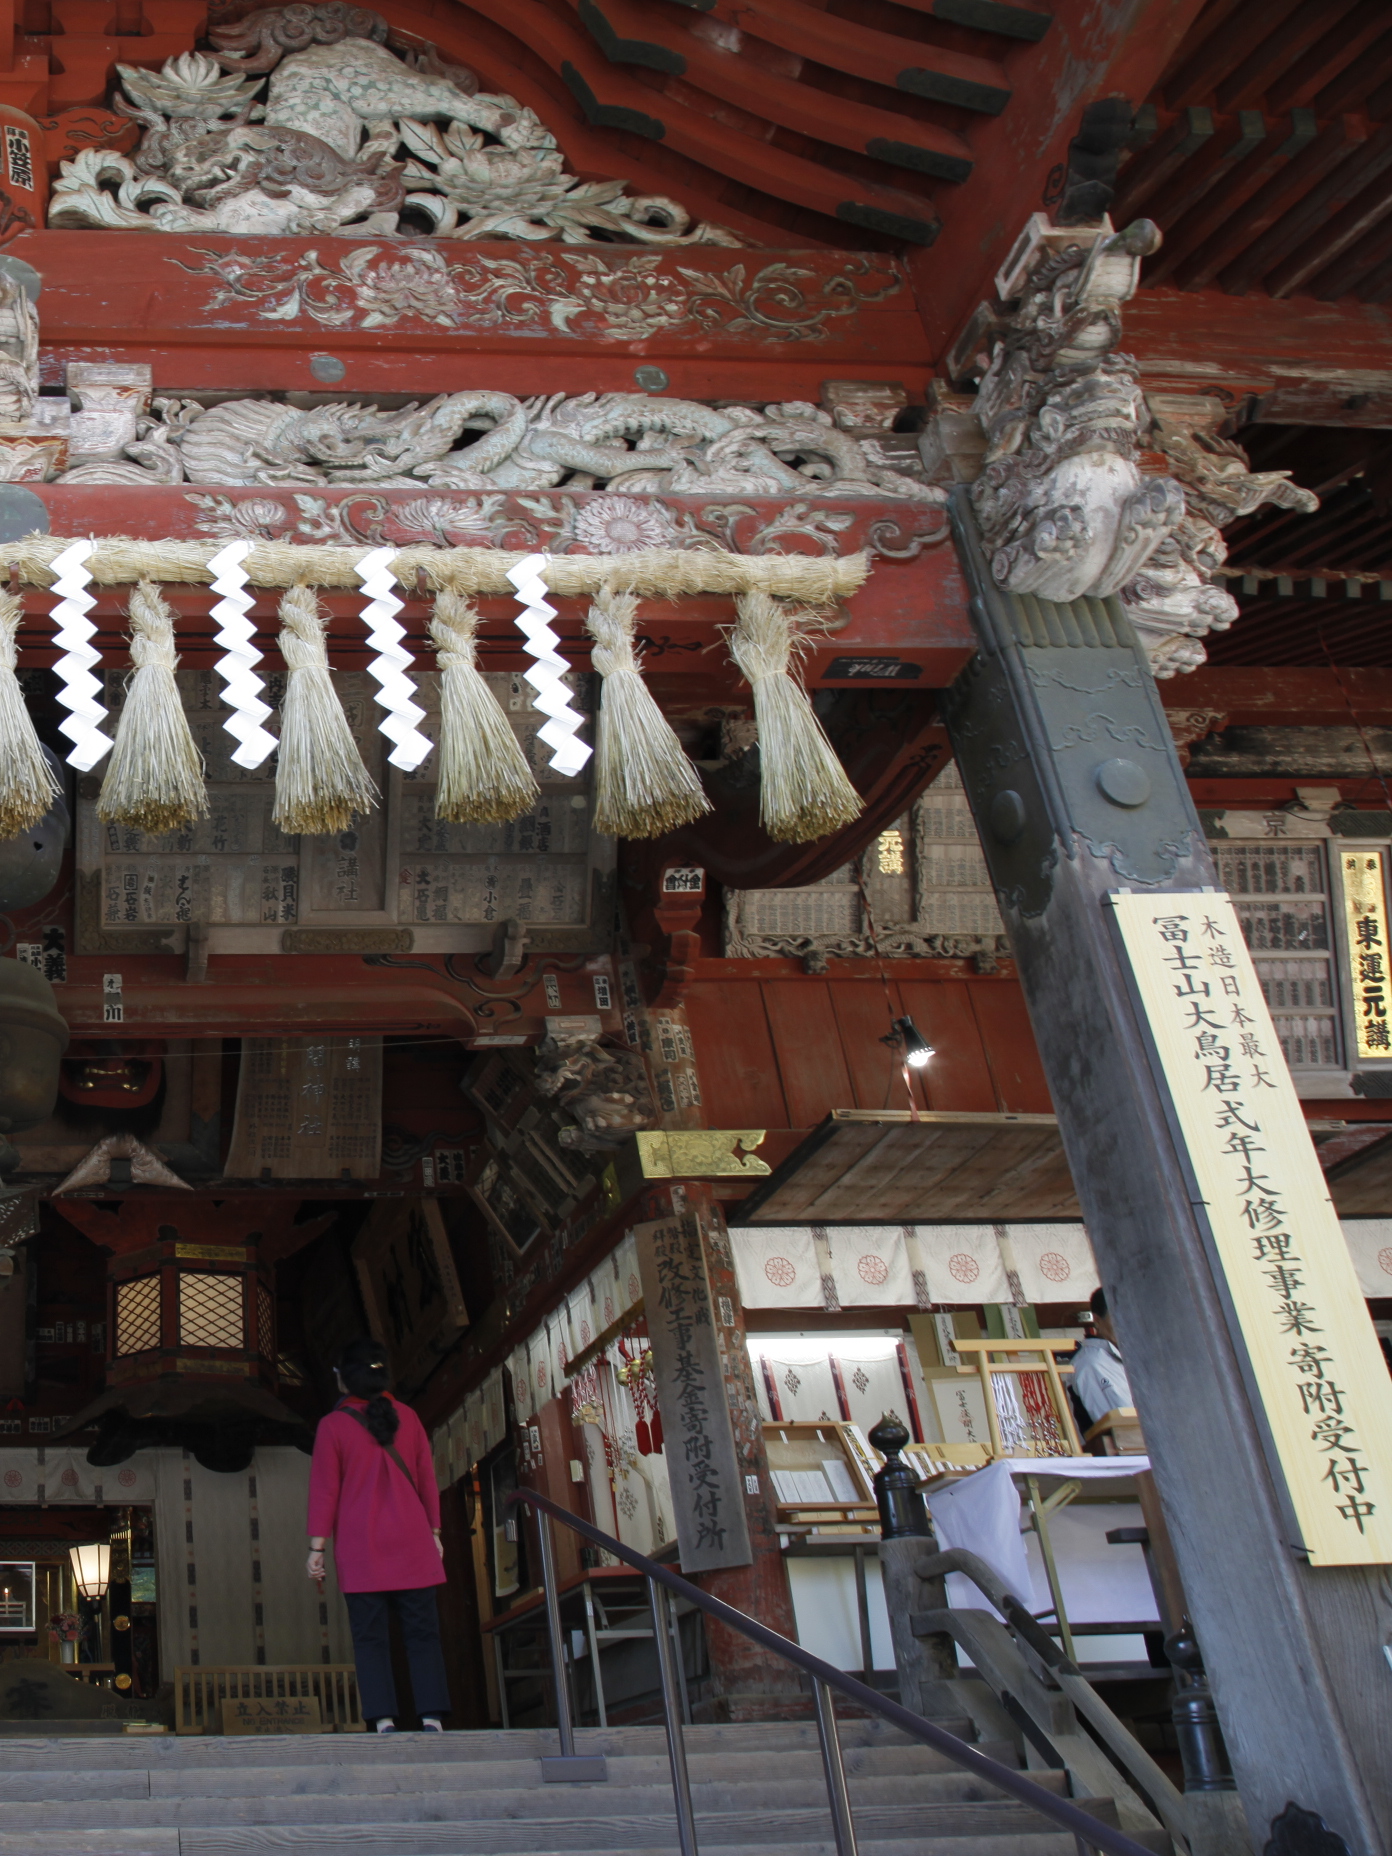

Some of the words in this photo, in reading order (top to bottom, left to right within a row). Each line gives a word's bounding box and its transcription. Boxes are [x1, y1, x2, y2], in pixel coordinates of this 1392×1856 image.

[10, 138, 32, 189] 小笠原
[1263, 813, 1288, 837] 京
[337, 856, 360, 904] 講社
[44, 931, 66, 982] 大義
[597, 986, 609, 1007] 増田
[1200, 915, 1277, 1088] 木造日本最大
[1355, 916, 1392, 1049] 東運元講
[655, 1257, 727, 1551] 改修工事基金寄附受付所
[235, 1700, 311, 1717] 立入禁止
